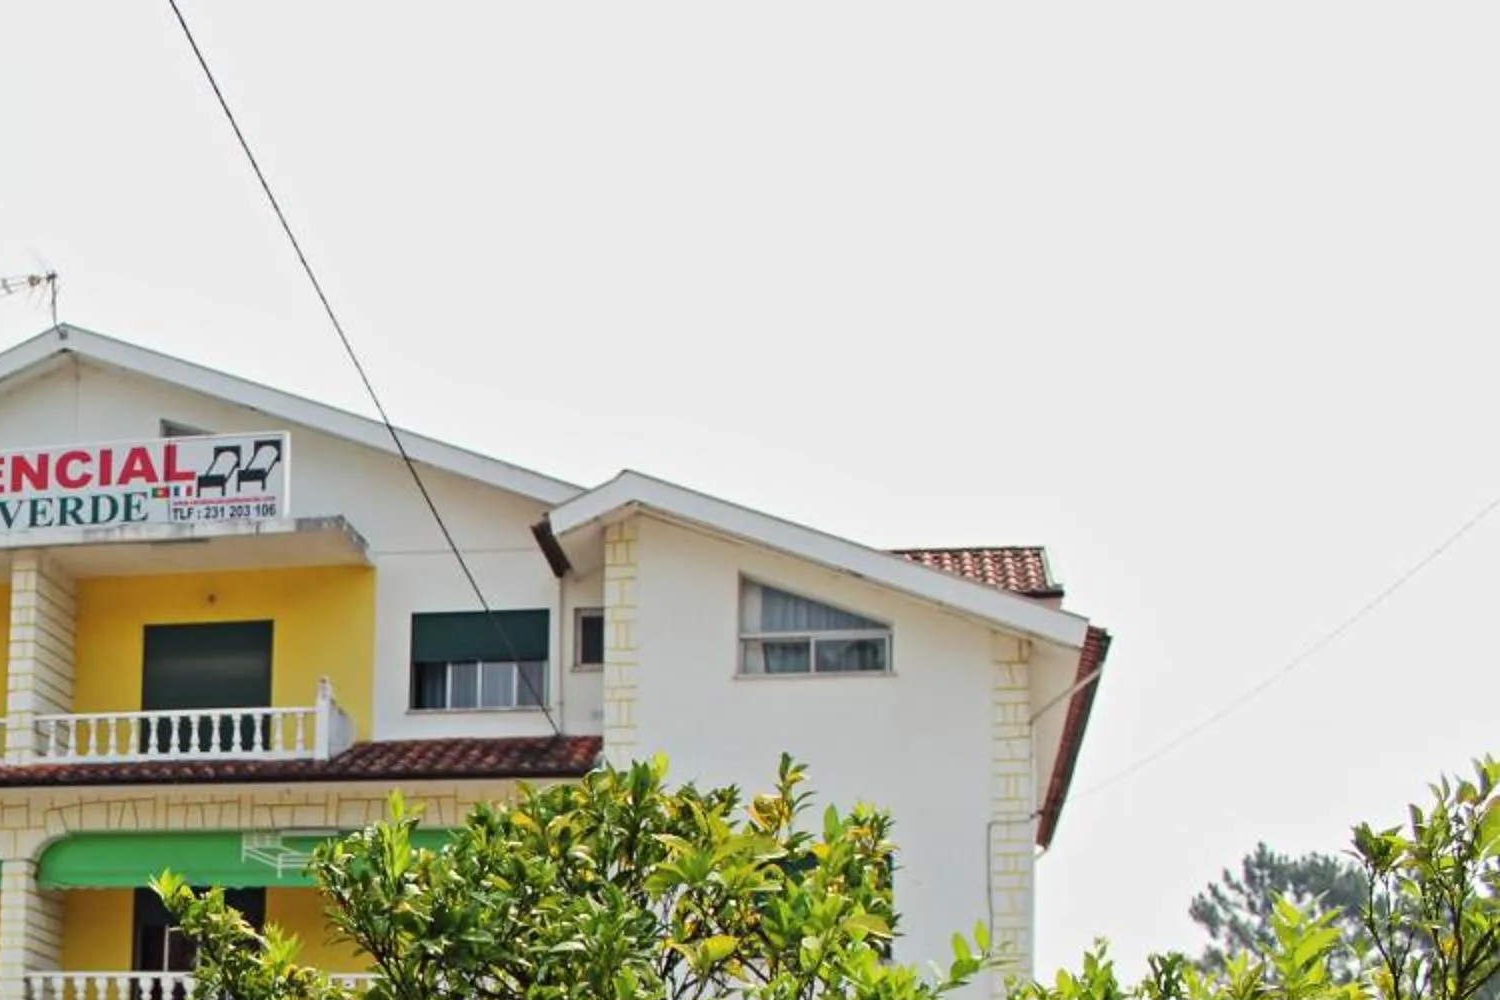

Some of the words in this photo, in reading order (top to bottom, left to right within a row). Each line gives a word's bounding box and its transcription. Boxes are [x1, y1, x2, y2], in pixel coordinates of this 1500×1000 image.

[204, 505, 225, 519] 231
[229, 504, 251, 518] 203
[255, 503, 277, 517] 106
